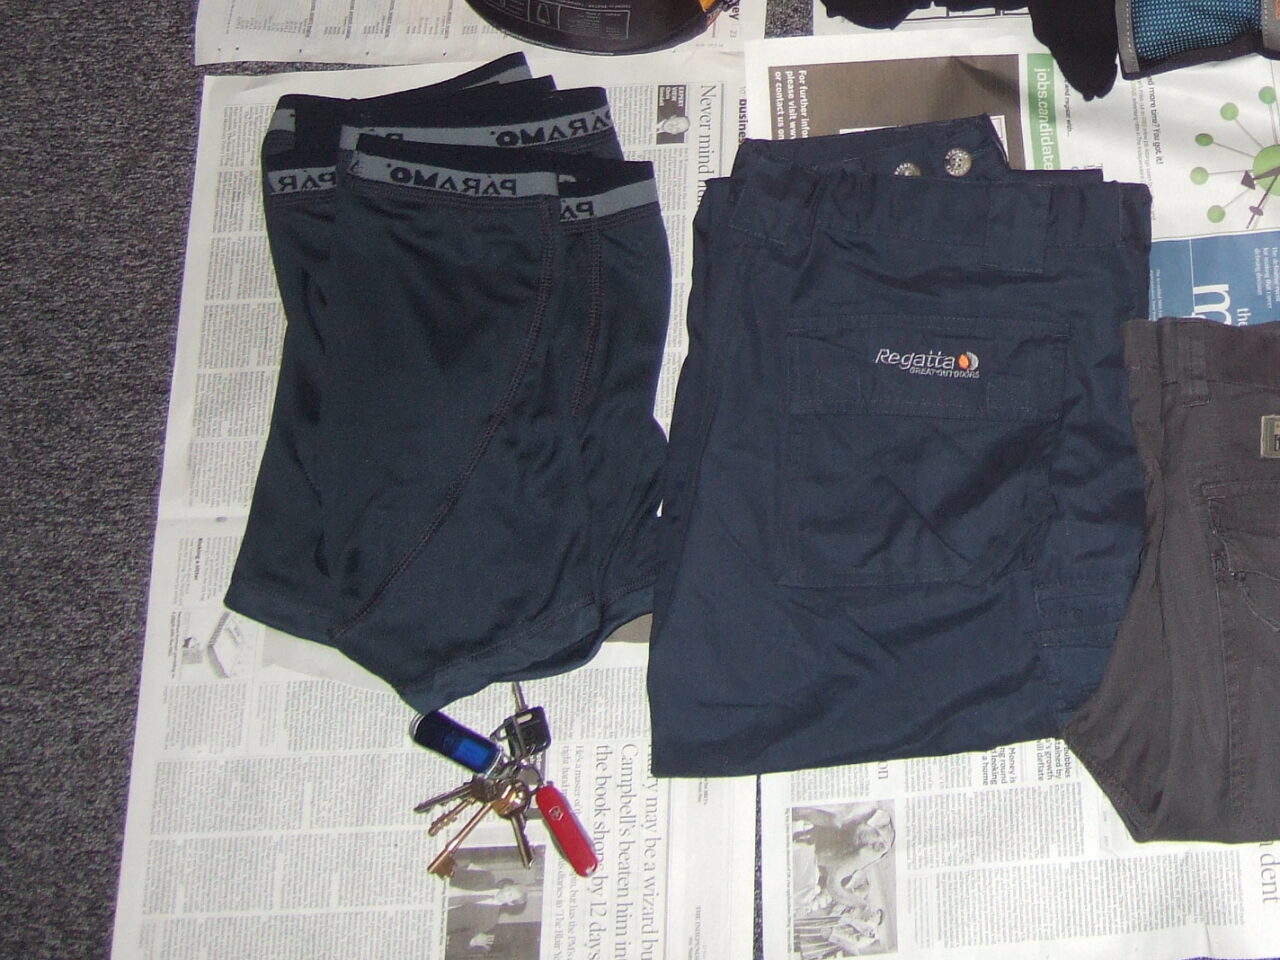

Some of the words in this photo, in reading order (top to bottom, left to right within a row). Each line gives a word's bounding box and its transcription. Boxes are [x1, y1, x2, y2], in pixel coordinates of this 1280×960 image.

[775, 71, 782, 81] or
[785, 71, 795, 99] please
[798, 70, 807, 84] For
[699, 84, 717, 131] Never
[775, 83, 785, 115] contact
[800, 86, 809, 116] further
[1149, 87, 1157, 108] more
[787, 101, 797, 120] visit
[1151, 109, 1161, 127] time?
[777, 117, 785, 127] us
[1153, 129, 1162, 141] You
[698, 134, 718, 175] mind
[1152, 142, 1162, 153] got
[1155, 155, 1164, 164] it!
[1237, 308, 1252, 326] the
[875, 349, 955, 370] Regatta
[595, 745, 613, 772] the
[593, 776, 613, 818] book
[617, 743, 639, 836] Campbell's
[641, 797, 659, 833] may
[644, 838, 662, 859] be
[617, 840, 636, 898] beaten
[644, 862, 656, 872] a
[586, 876, 609, 896] by
[589, 902, 608, 917] 12
[641, 876, 660, 934] wizard
[614, 902, 634, 937] him
